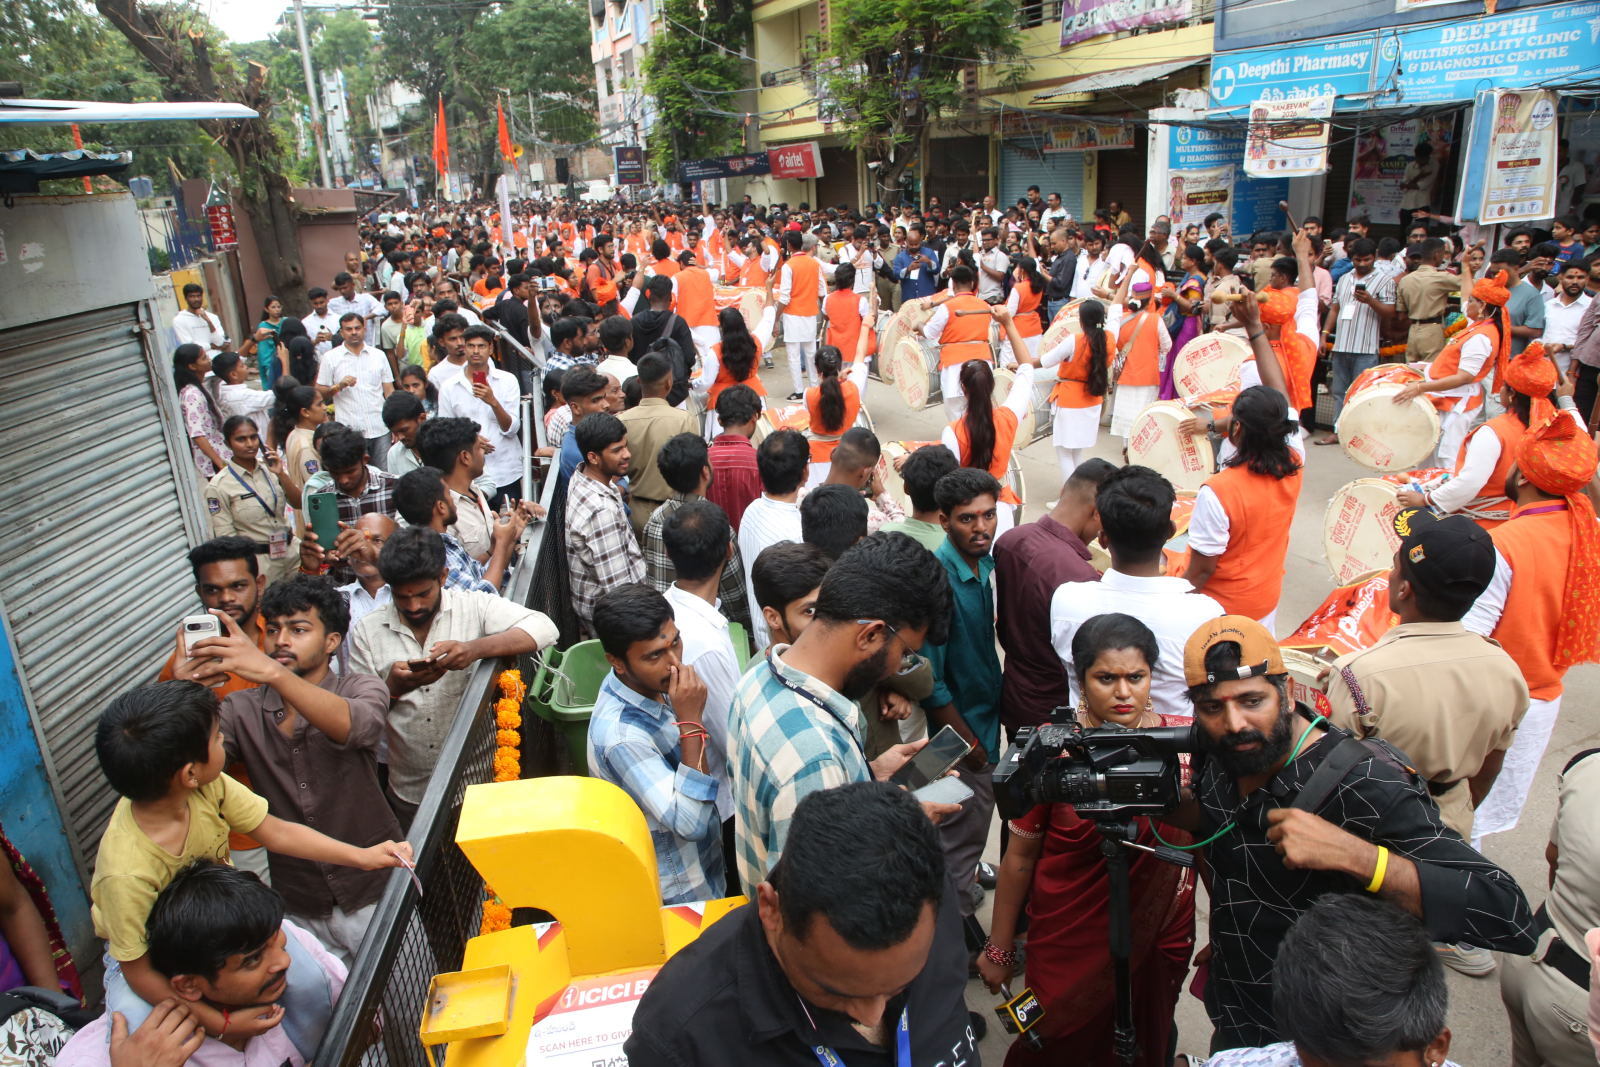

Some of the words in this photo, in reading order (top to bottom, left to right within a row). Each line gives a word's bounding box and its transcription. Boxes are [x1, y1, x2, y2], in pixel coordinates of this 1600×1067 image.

[1440, 15, 1539, 44] DEEPTHI
[1403, 36, 1523, 61] MULTISPECIALITY
[1526, 30, 1582, 47] CLINIC
[1238, 56, 1290, 79] Deepthi
[1293, 51, 1369, 72] Pharmacy
[1408, 63, 1419, 73] &
[1420, 53, 1505, 71] DIAGNOSTIC
[1507, 46, 1569, 63] CENTRE
[785, 152, 804, 168] airtel
[1187, 154, 1230, 162] DIAGNOSTIC
[577, 984, 631, 1006] ICICI
[539, 1041, 566, 1054] SCAN
[568, 1038, 593, 1050] HERE
[597, 1033, 609, 1043] TO
[611, 1029, 633, 1041] GIVE
